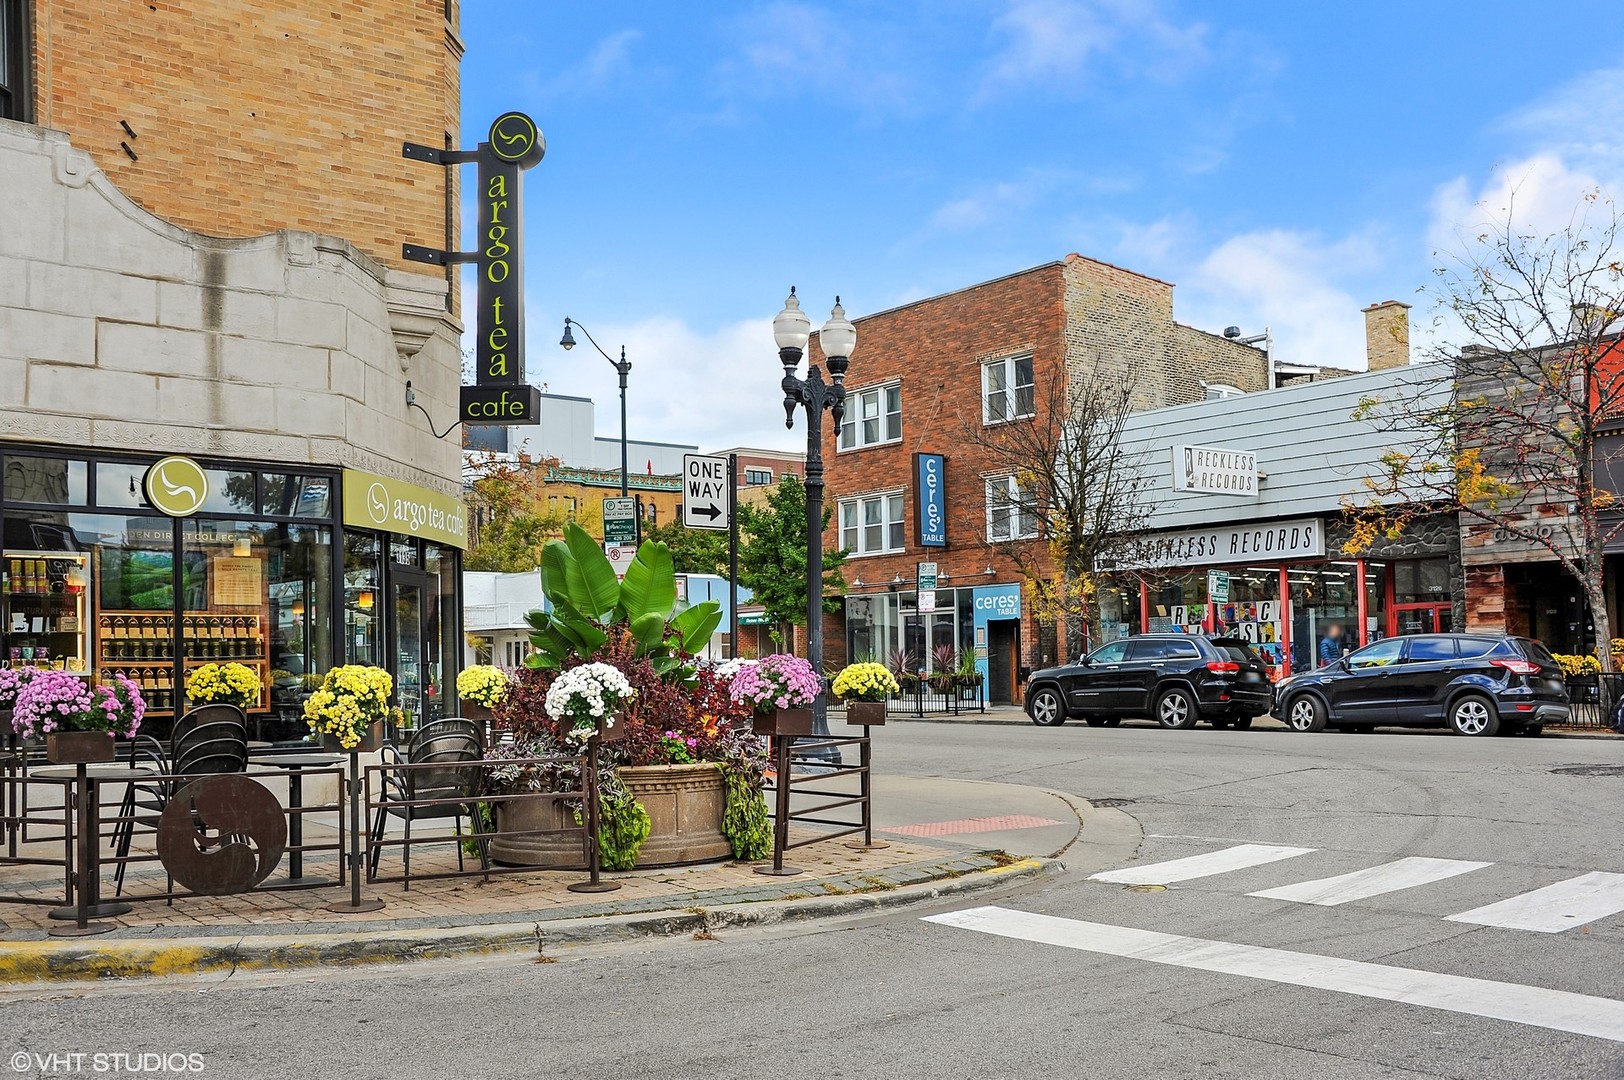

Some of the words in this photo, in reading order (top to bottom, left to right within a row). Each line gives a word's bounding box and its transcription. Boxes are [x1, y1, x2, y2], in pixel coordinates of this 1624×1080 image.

[486, 175, 510, 283] argo
[488, 297, 509, 377] tea
[690, 461, 722, 479] ONE
[1197, 451, 1254, 471] RECKLESS
[689, 481, 723, 499] WAY
[1201, 472, 1252, 491] RECORDS
[393, 499, 426, 531] argo
[428, 502, 445, 531] tea
[194, 532, 259, 543] COLLECN
[922, 533, 944, 542] TABLE
[1230, 526, 1312, 555] RECORDS
[997, 608, 1018, 616] TABLE
